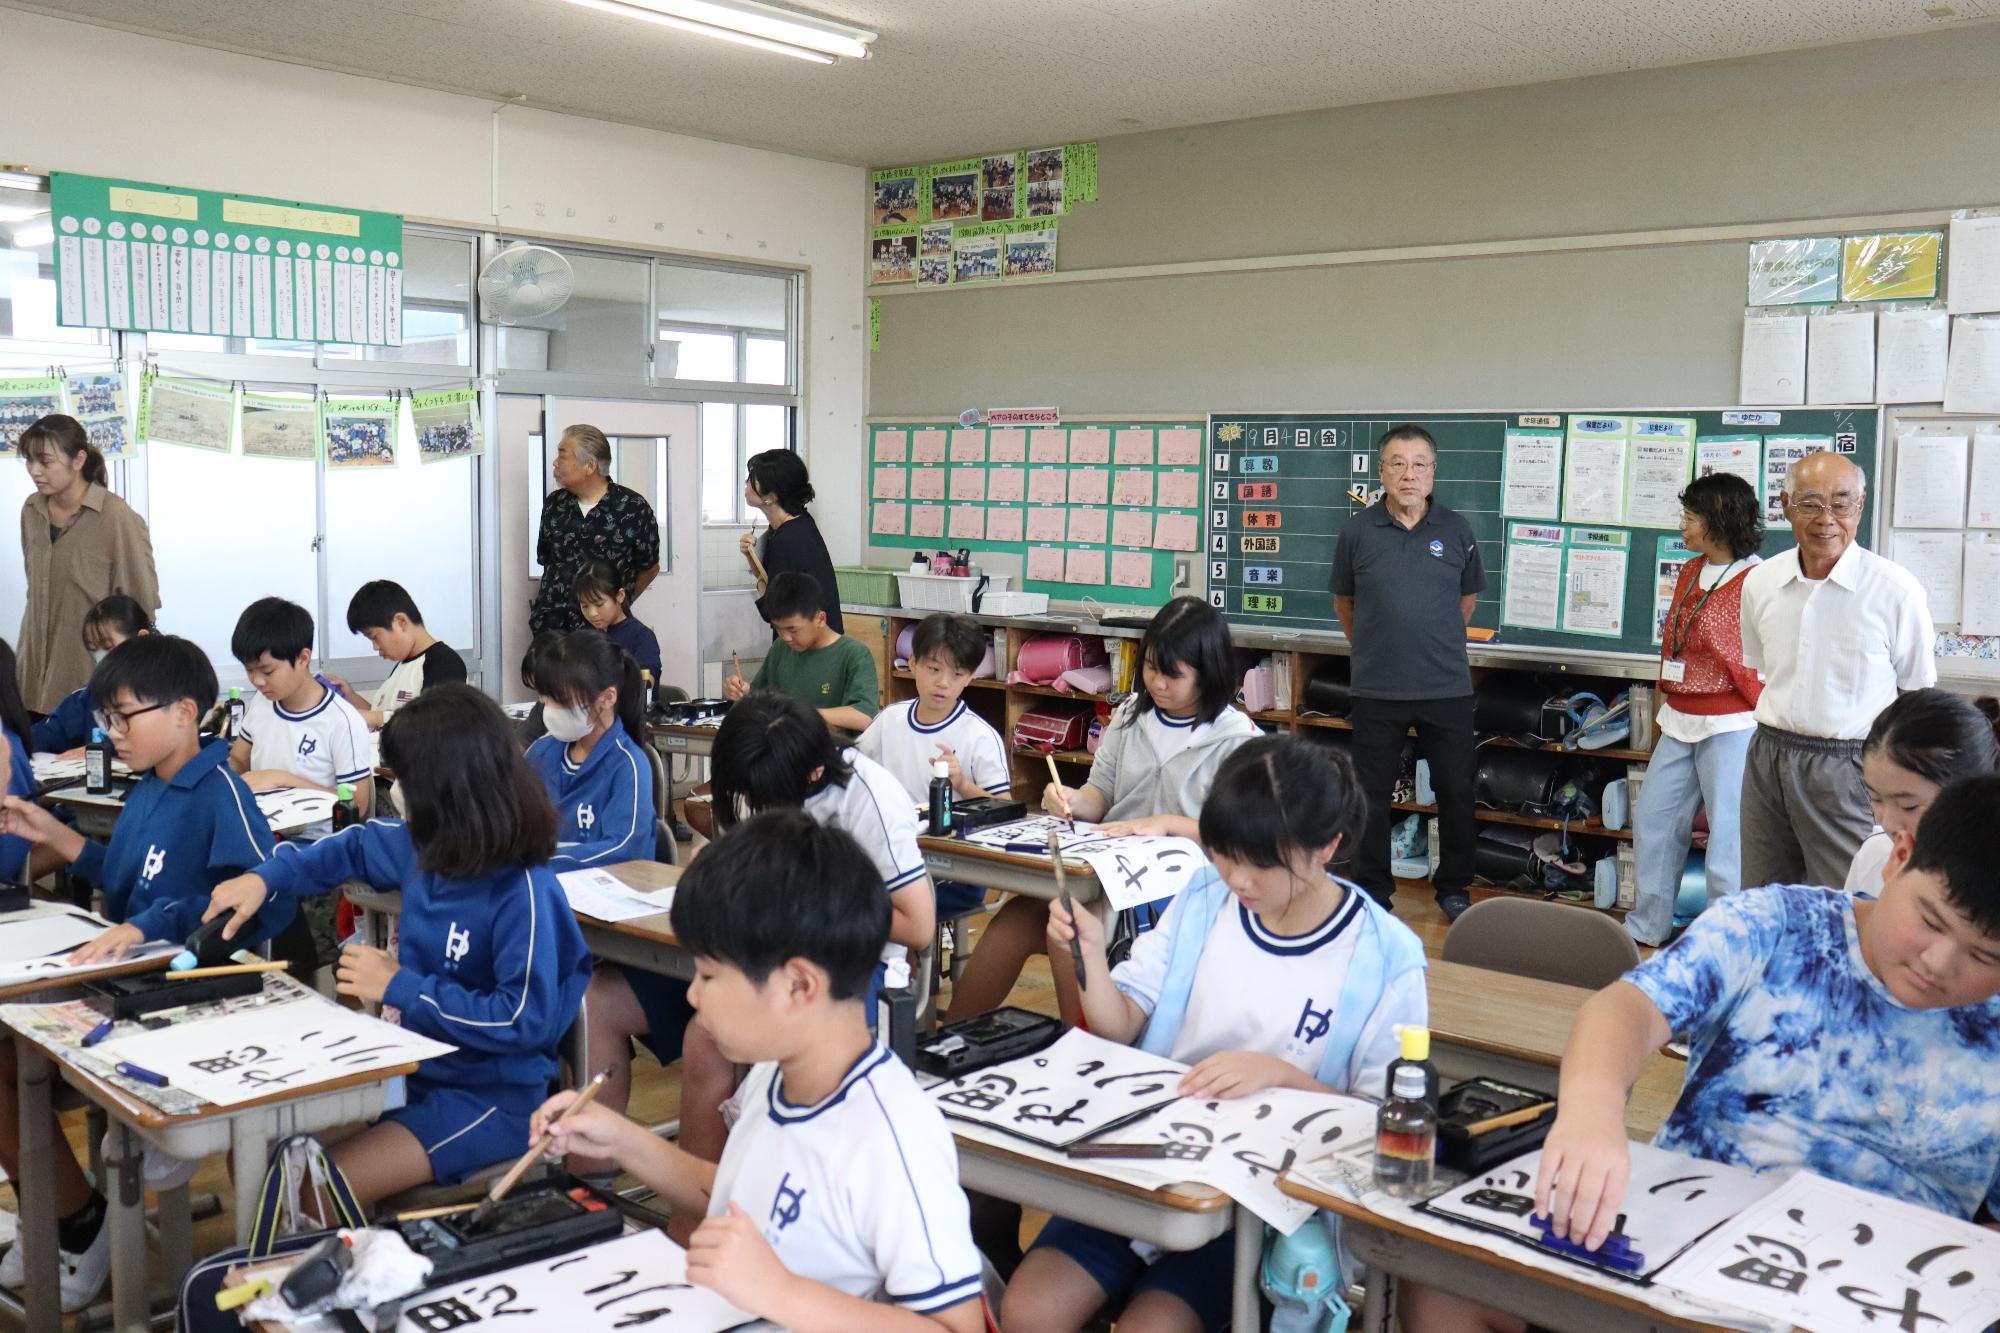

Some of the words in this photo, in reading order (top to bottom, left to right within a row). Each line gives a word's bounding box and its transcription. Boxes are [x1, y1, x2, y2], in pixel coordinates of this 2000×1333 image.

[991, 413, 1058, 421] ペアの子のすてきなところ
[1741, 413, 1762, 421] ゆたか
[1837, 435, 1855, 453] 宿
[1220, 456, 1225, 470] 1
[1244, 458, 1274, 471] 算数
[1217, 485, 1225, 498] 2
[1243, 486, 1272, 498] 国語
[1217, 513, 1225, 526] 3
[1247, 513, 1277, 526] 体育
[1215, 537, 1224, 550] 4
[1244, 538, 1277, 551] 外国語
[1215, 564, 1223, 577] 5
[1249, 569, 1278, 582] 音楽
[1214, 593, 1222, 606] 6
[1248, 596, 1277, 610] 理科
